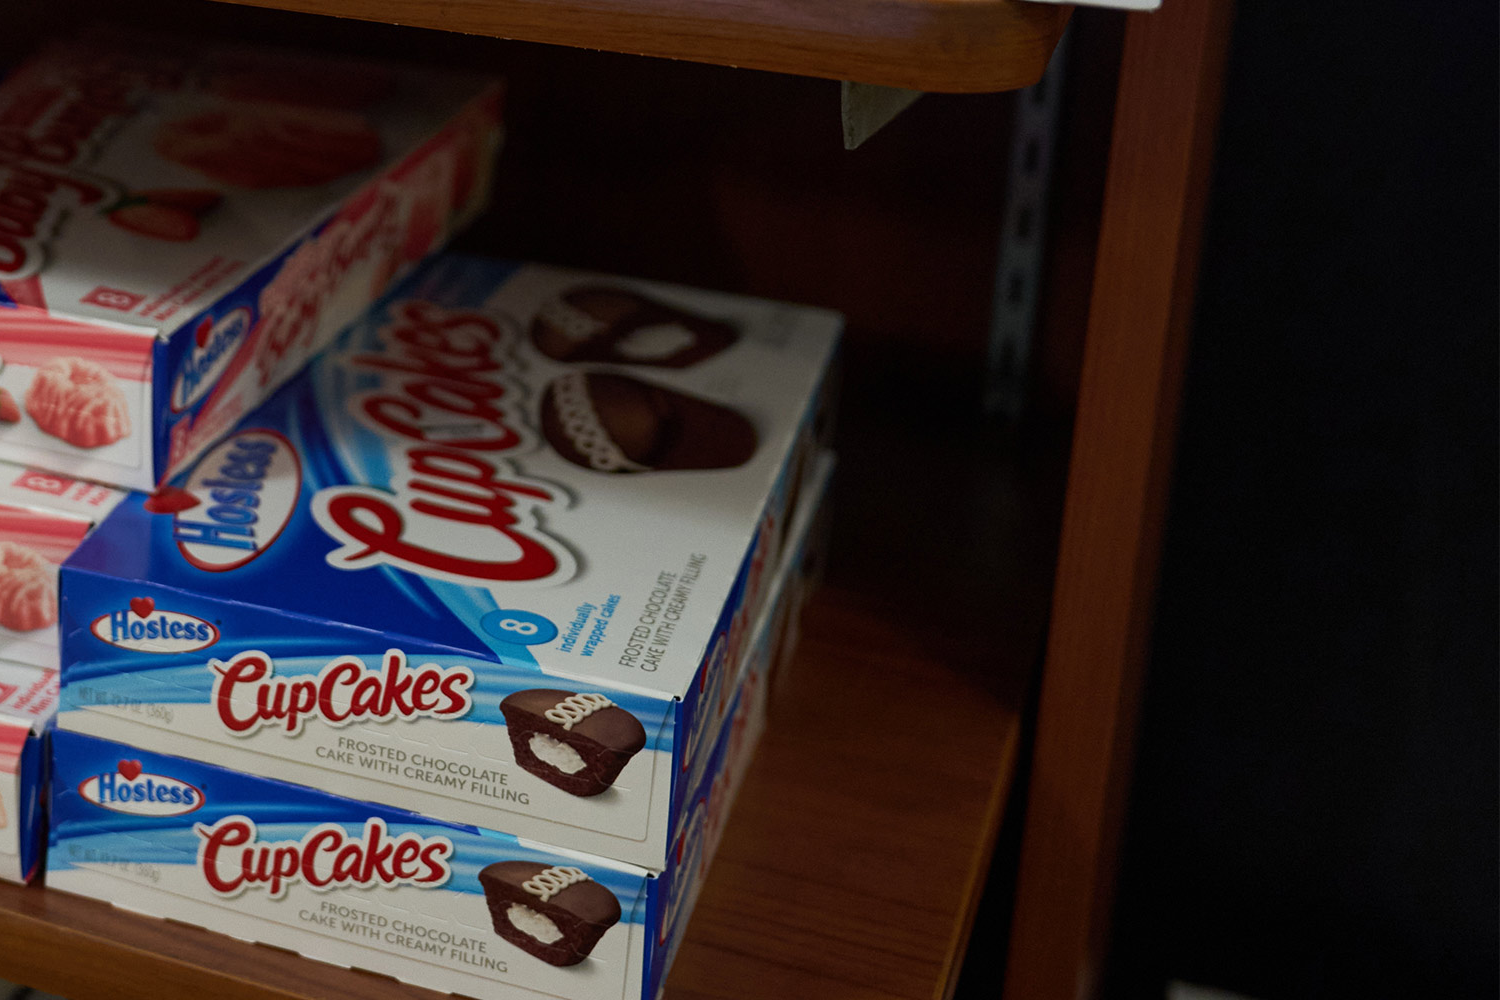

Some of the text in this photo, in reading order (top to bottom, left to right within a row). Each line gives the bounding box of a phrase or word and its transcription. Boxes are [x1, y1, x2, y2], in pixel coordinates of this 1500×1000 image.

[329, 302, 557, 582] CupCakes
[173, 436, 278, 552] Hostess
[111, 606, 210, 644] Hostess
[500, 618, 539, 636] 8
[556, 601, 597, 653] individually
[581, 593, 621, 657] wrapped cakes
[619, 570, 677, 668] FROSTED CHOCOLATE
[641, 552, 707, 672] CAKE WITH CREAMY FILLING
[213, 654, 468, 732] CupCakes
[100, 772, 194, 805] Hostess
[315, 746, 530, 806] CAKE WITH CREAMY FILLING
[338, 736, 508, 786] FROSTED CHOCOLATE
[198, 821, 448, 895] CupCakes
[299, 908, 508, 974] CAKE WITH CREAMY FILLING
[320, 901, 487, 954] FROSTED CHOCOLATE
